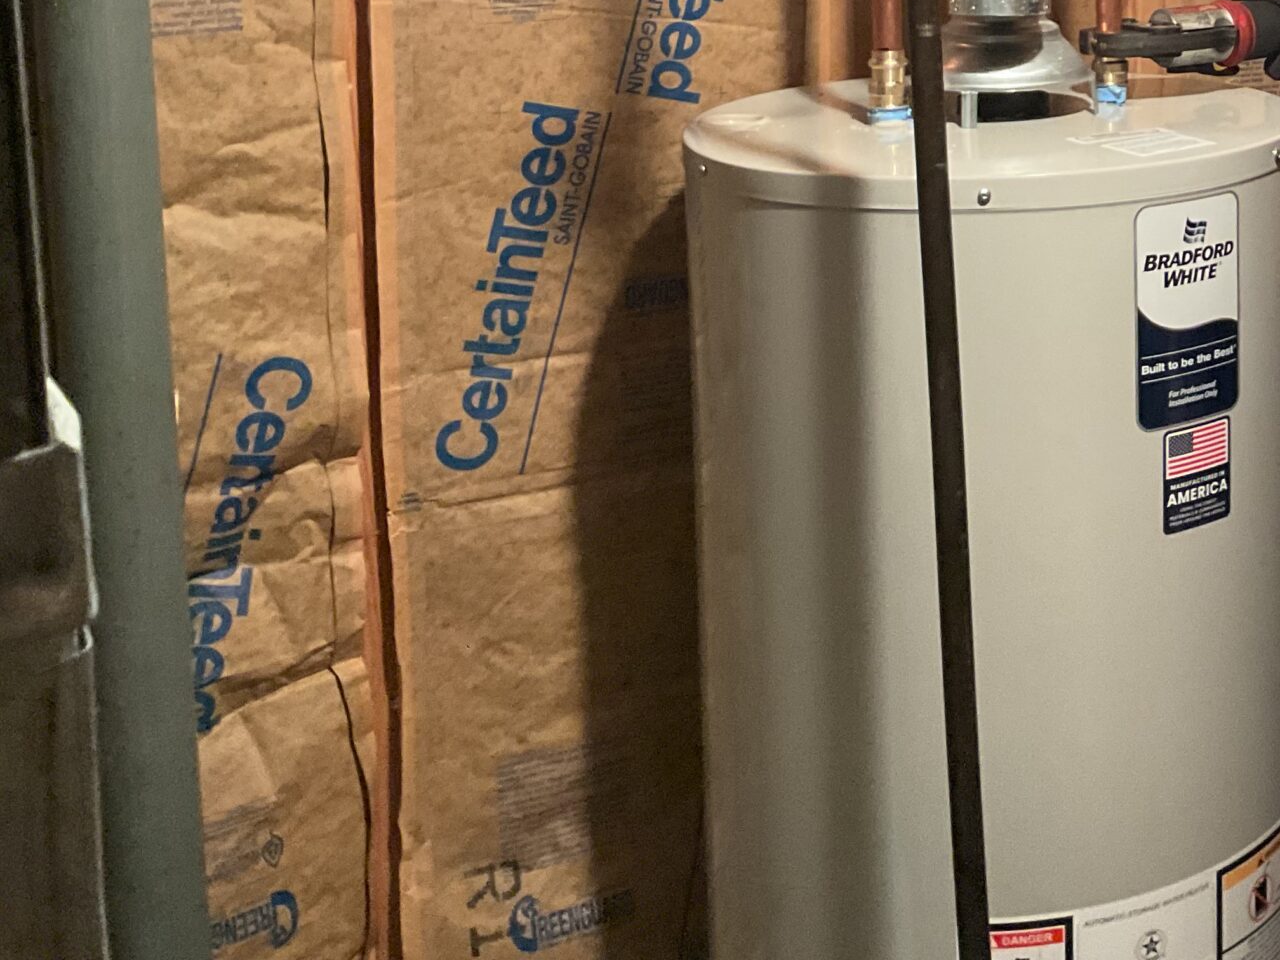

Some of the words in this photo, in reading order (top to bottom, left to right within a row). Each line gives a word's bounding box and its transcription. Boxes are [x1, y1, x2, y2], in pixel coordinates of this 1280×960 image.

[554, 110, 601, 246] SAINT-GOBAIN
[1143, 240, 1234, 272] BRADFORD
[435, 100, 580, 471] CertainTeed
[1164, 263, 1218, 288] WHITE
[1141, 362, 1165, 375] Built
[1168, 361, 1178, 371] to
[1181, 358, 1194, 368] be
[1196, 353, 1211, 364] the
[1168, 390, 1179, 398] For
[1180, 380, 1217, 396] Professional
[1168, 393, 1204, 407] Installation
[1204, 389, 1218, 399] Only
[1166, 478, 1228, 508] AMERICA
[1170, 473, 1218, 491] MANUFACTURED
[1001, 932, 1053, 947] DANGER
